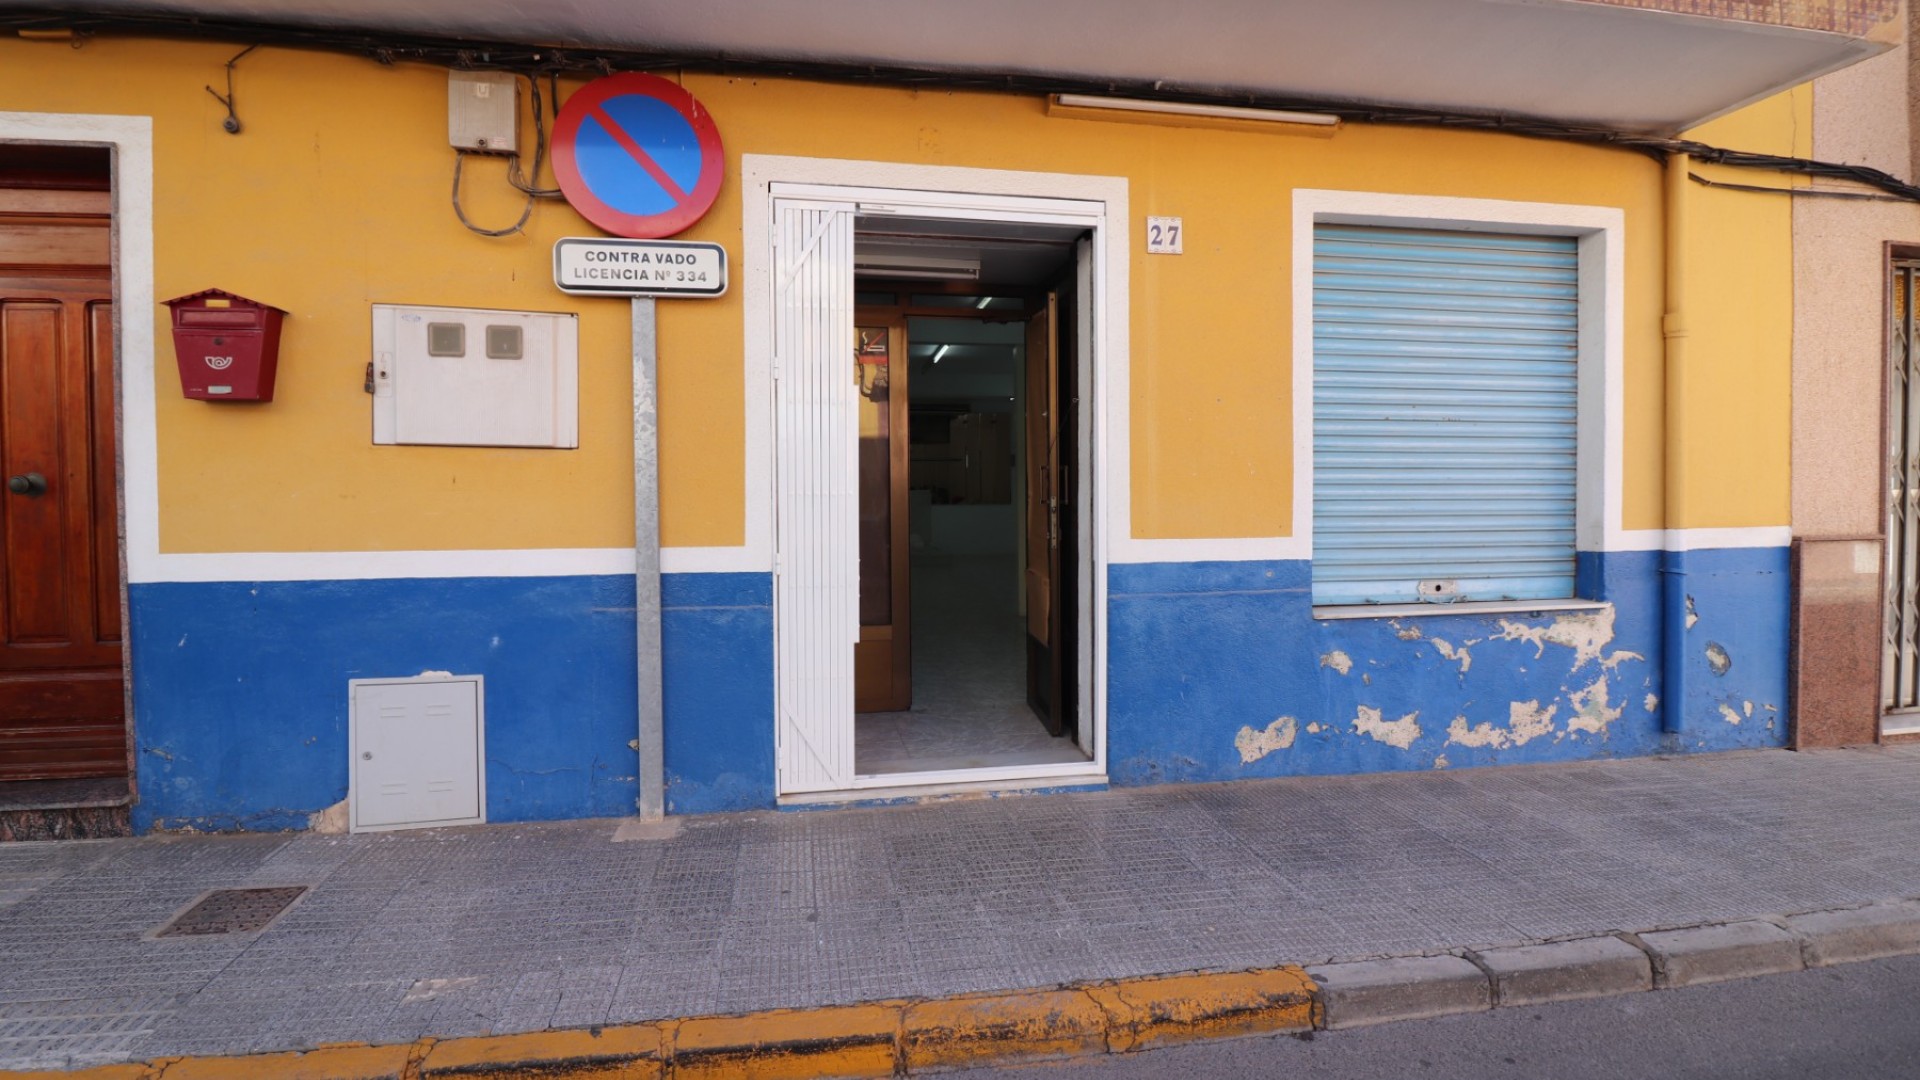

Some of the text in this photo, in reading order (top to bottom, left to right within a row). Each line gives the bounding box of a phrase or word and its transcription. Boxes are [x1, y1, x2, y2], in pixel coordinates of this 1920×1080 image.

[1150, 224, 1179, 246] 27
[585, 251, 697, 265] CONTRA VADO
[574, 267, 649, 281] LICENCIA
[676, 270, 707, 282] 334
